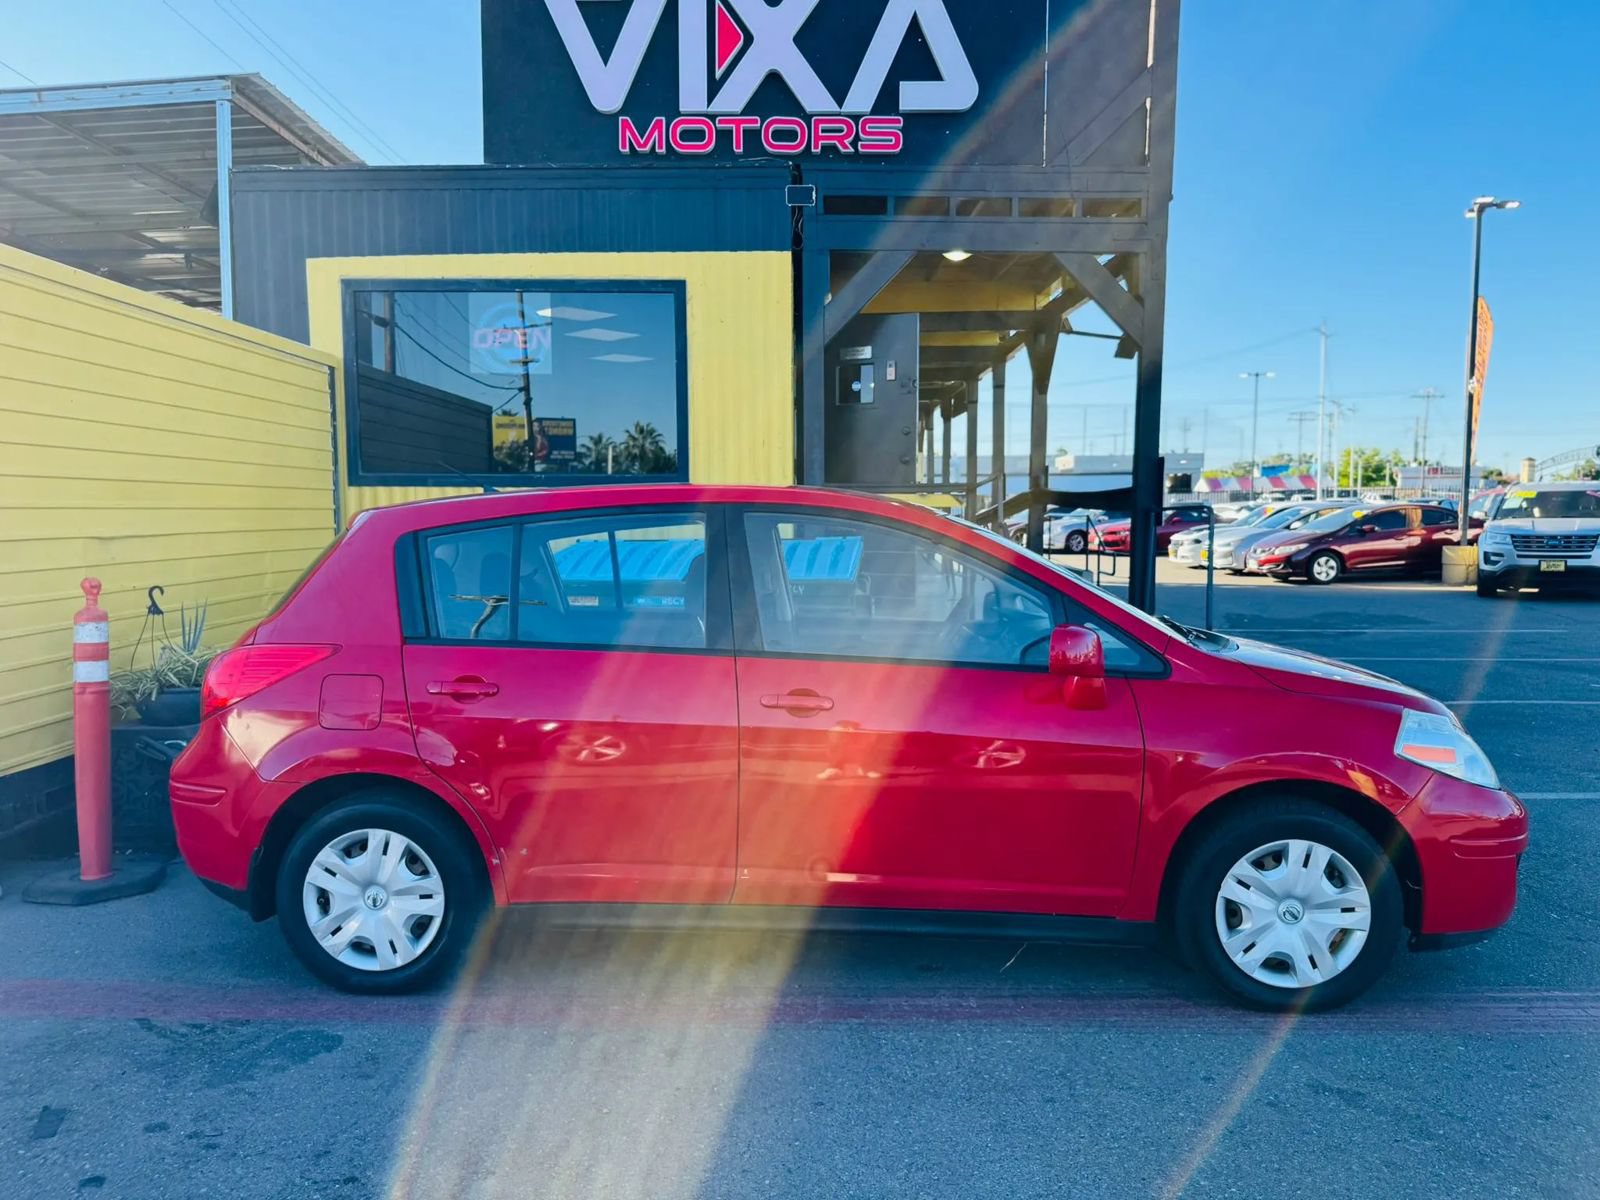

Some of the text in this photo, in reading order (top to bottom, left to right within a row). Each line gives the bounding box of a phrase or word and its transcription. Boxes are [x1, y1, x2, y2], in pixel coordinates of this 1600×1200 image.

[544, 0, 979, 114] VIXA
[618, 116, 904, 154] MOTORS
[472, 328, 552, 349] OPEN
